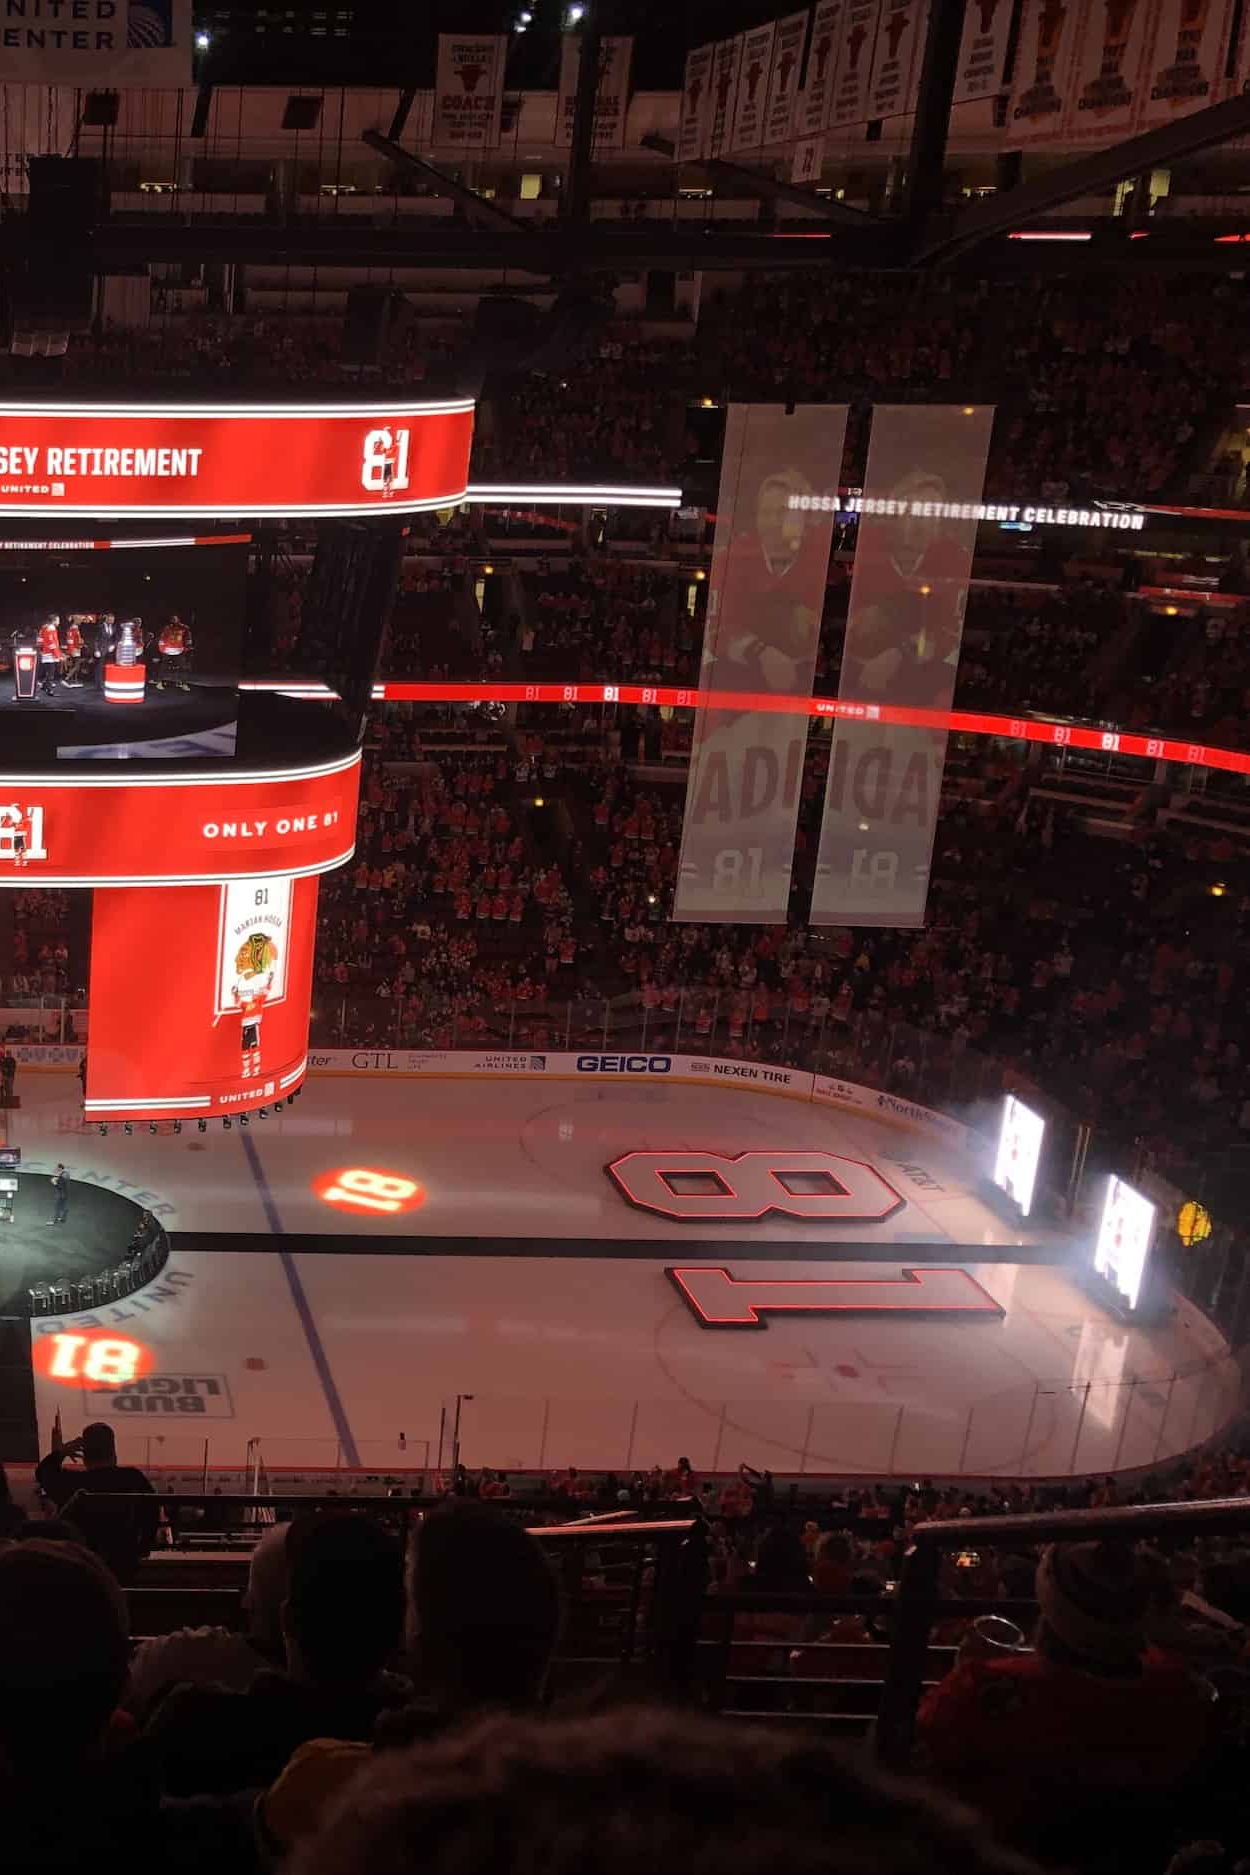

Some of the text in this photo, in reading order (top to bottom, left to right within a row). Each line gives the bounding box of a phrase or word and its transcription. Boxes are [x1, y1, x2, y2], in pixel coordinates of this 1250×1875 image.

[48, 447, 204, 477] RETIREMENT
[361, 428, 411, 491] 81
[0, 484, 49, 495] UNITED
[788, 495, 1145, 531] HOSSA JERSEY RETIREMENT CELEBRATION
[564, 687, 578, 701] 81
[604, 687, 619, 701] 81
[642, 688, 657, 703] 81
[817, 704, 864, 716] UNITED
[1054, 727, 1071, 744] 81
[1102, 733, 1119, 751] 81
[1147, 740, 1164, 758] 81
[203, 811, 339, 838] ONLY ONE 81
[254, 888, 269, 906] 81
[352, 1052, 399, 1069] GTL
[577, 1056, 672, 1073] GEICO
[714, 1064, 791, 1084] NEXEN TIRE
[220, 1088, 263, 1105] UNITED
[36, 1269, 193, 1335] UNITED
[112, 1395, 206, 1413] BUD
